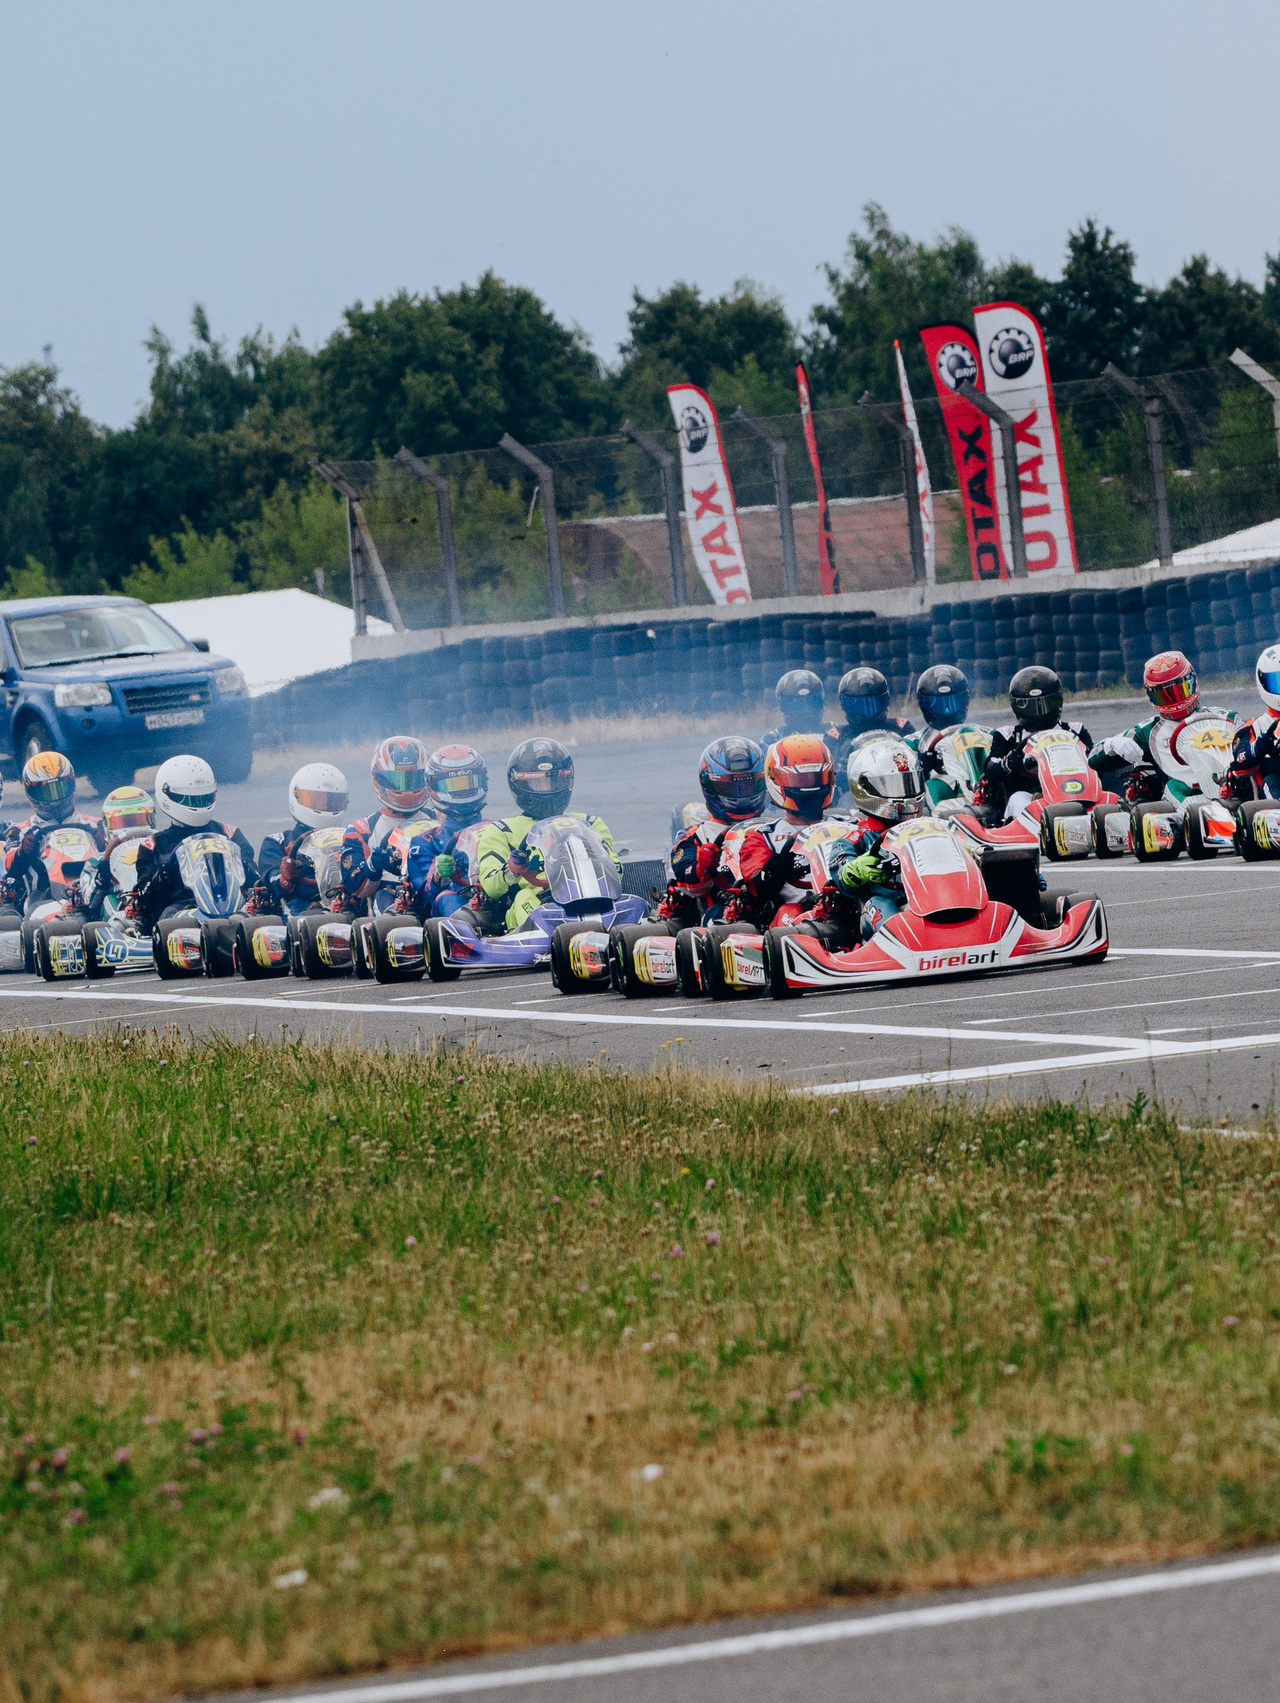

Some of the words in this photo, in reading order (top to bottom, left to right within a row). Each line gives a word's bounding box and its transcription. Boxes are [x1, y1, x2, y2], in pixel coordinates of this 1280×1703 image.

[1008, 349, 1034, 365] BRP
[955, 366, 976, 379] BRP
[956, 734, 988, 747] 12
[651, 957, 675, 975] birelart
[918, 949, 999, 972] birelart
